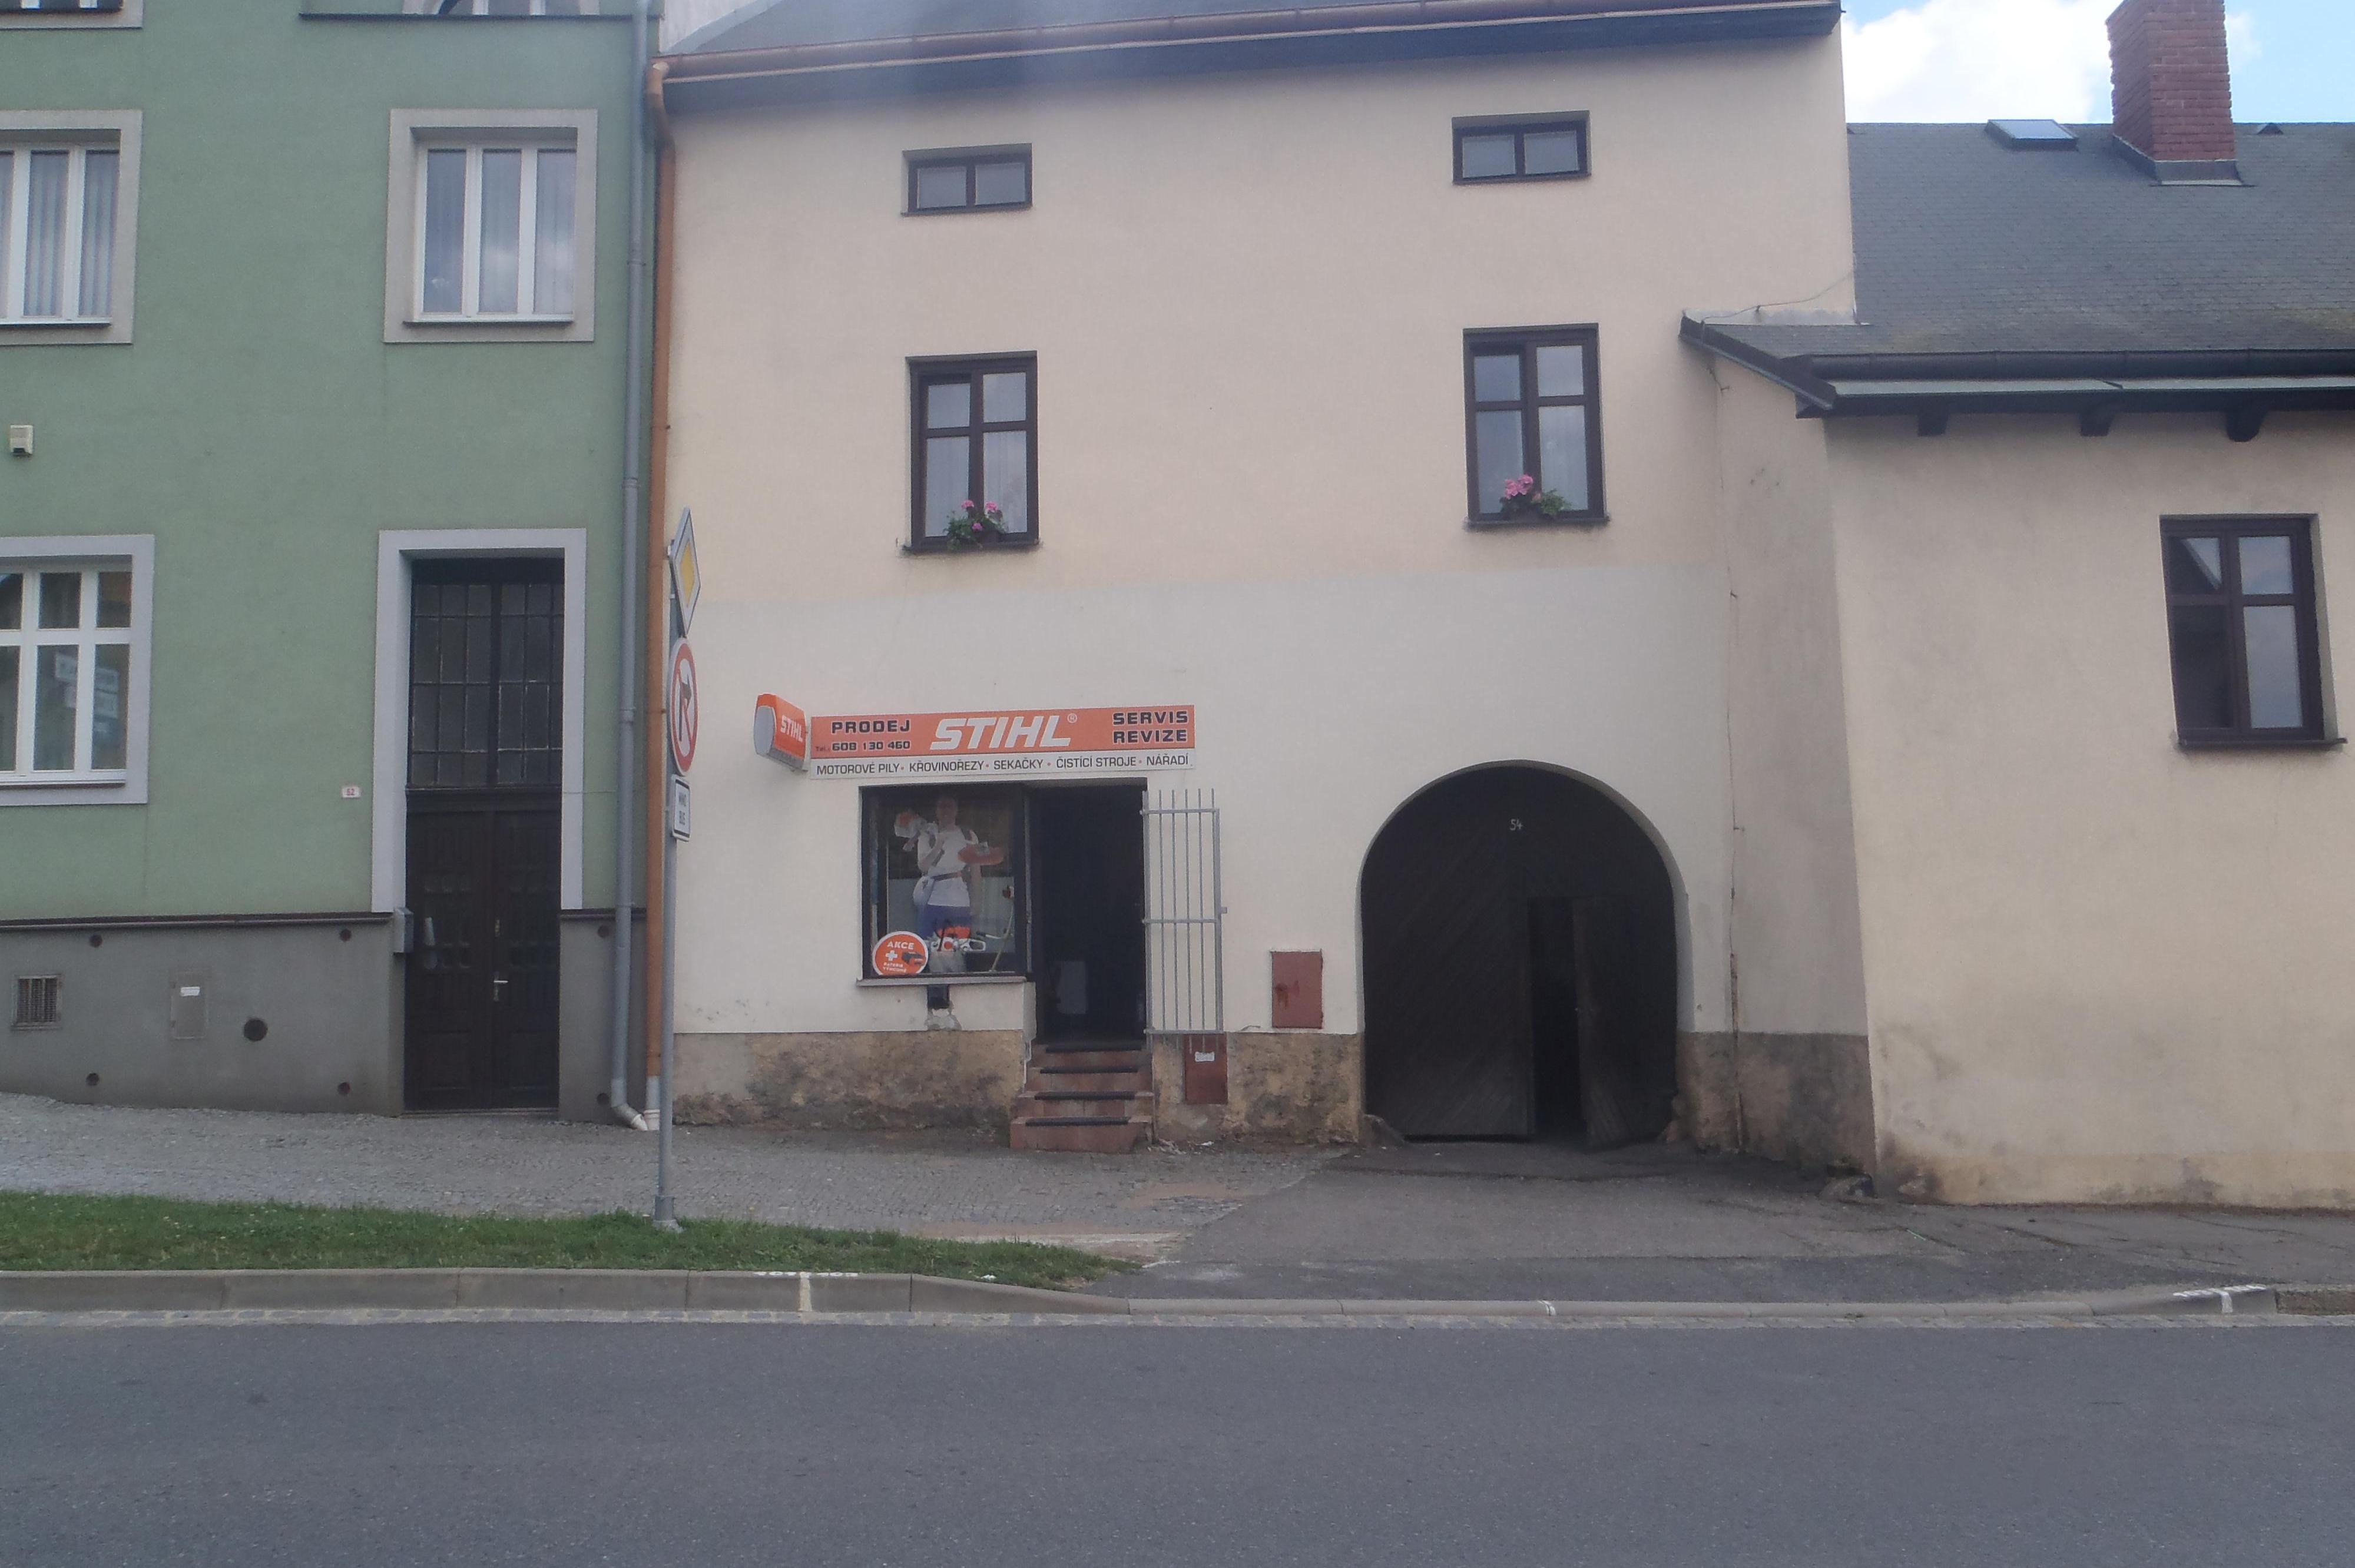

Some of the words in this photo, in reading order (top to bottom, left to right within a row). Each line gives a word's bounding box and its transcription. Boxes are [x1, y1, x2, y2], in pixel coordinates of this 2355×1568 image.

[1112, 710, 1188, 726] SERVIS
[780, 714, 803, 742] STIHL
[832, 720, 910, 734] PRODEJ
[930, 715, 1071, 750] STIHL
[1112, 729, 1187, 744] REVIZE
[832, 742, 857, 752] 608
[863, 741, 884, 750] 130
[887, 740, 911, 750] 460
[817, 761, 875, 775] MOTOROVÉ
[878, 763, 900, 773] PILY
[909, 759, 984, 773] KŘOVINOŘEZY
[993, 757, 1043, 770] SEKAČKY
[1056, 755, 1092, 769] ČISTÍCÍ
[1096, 756, 1137, 767] STROJE
[1146, 752, 1189, 766] NÁŘADÍ
[1509, 818, 1524, 831] 54
[887, 941, 915, 950] AKCE
